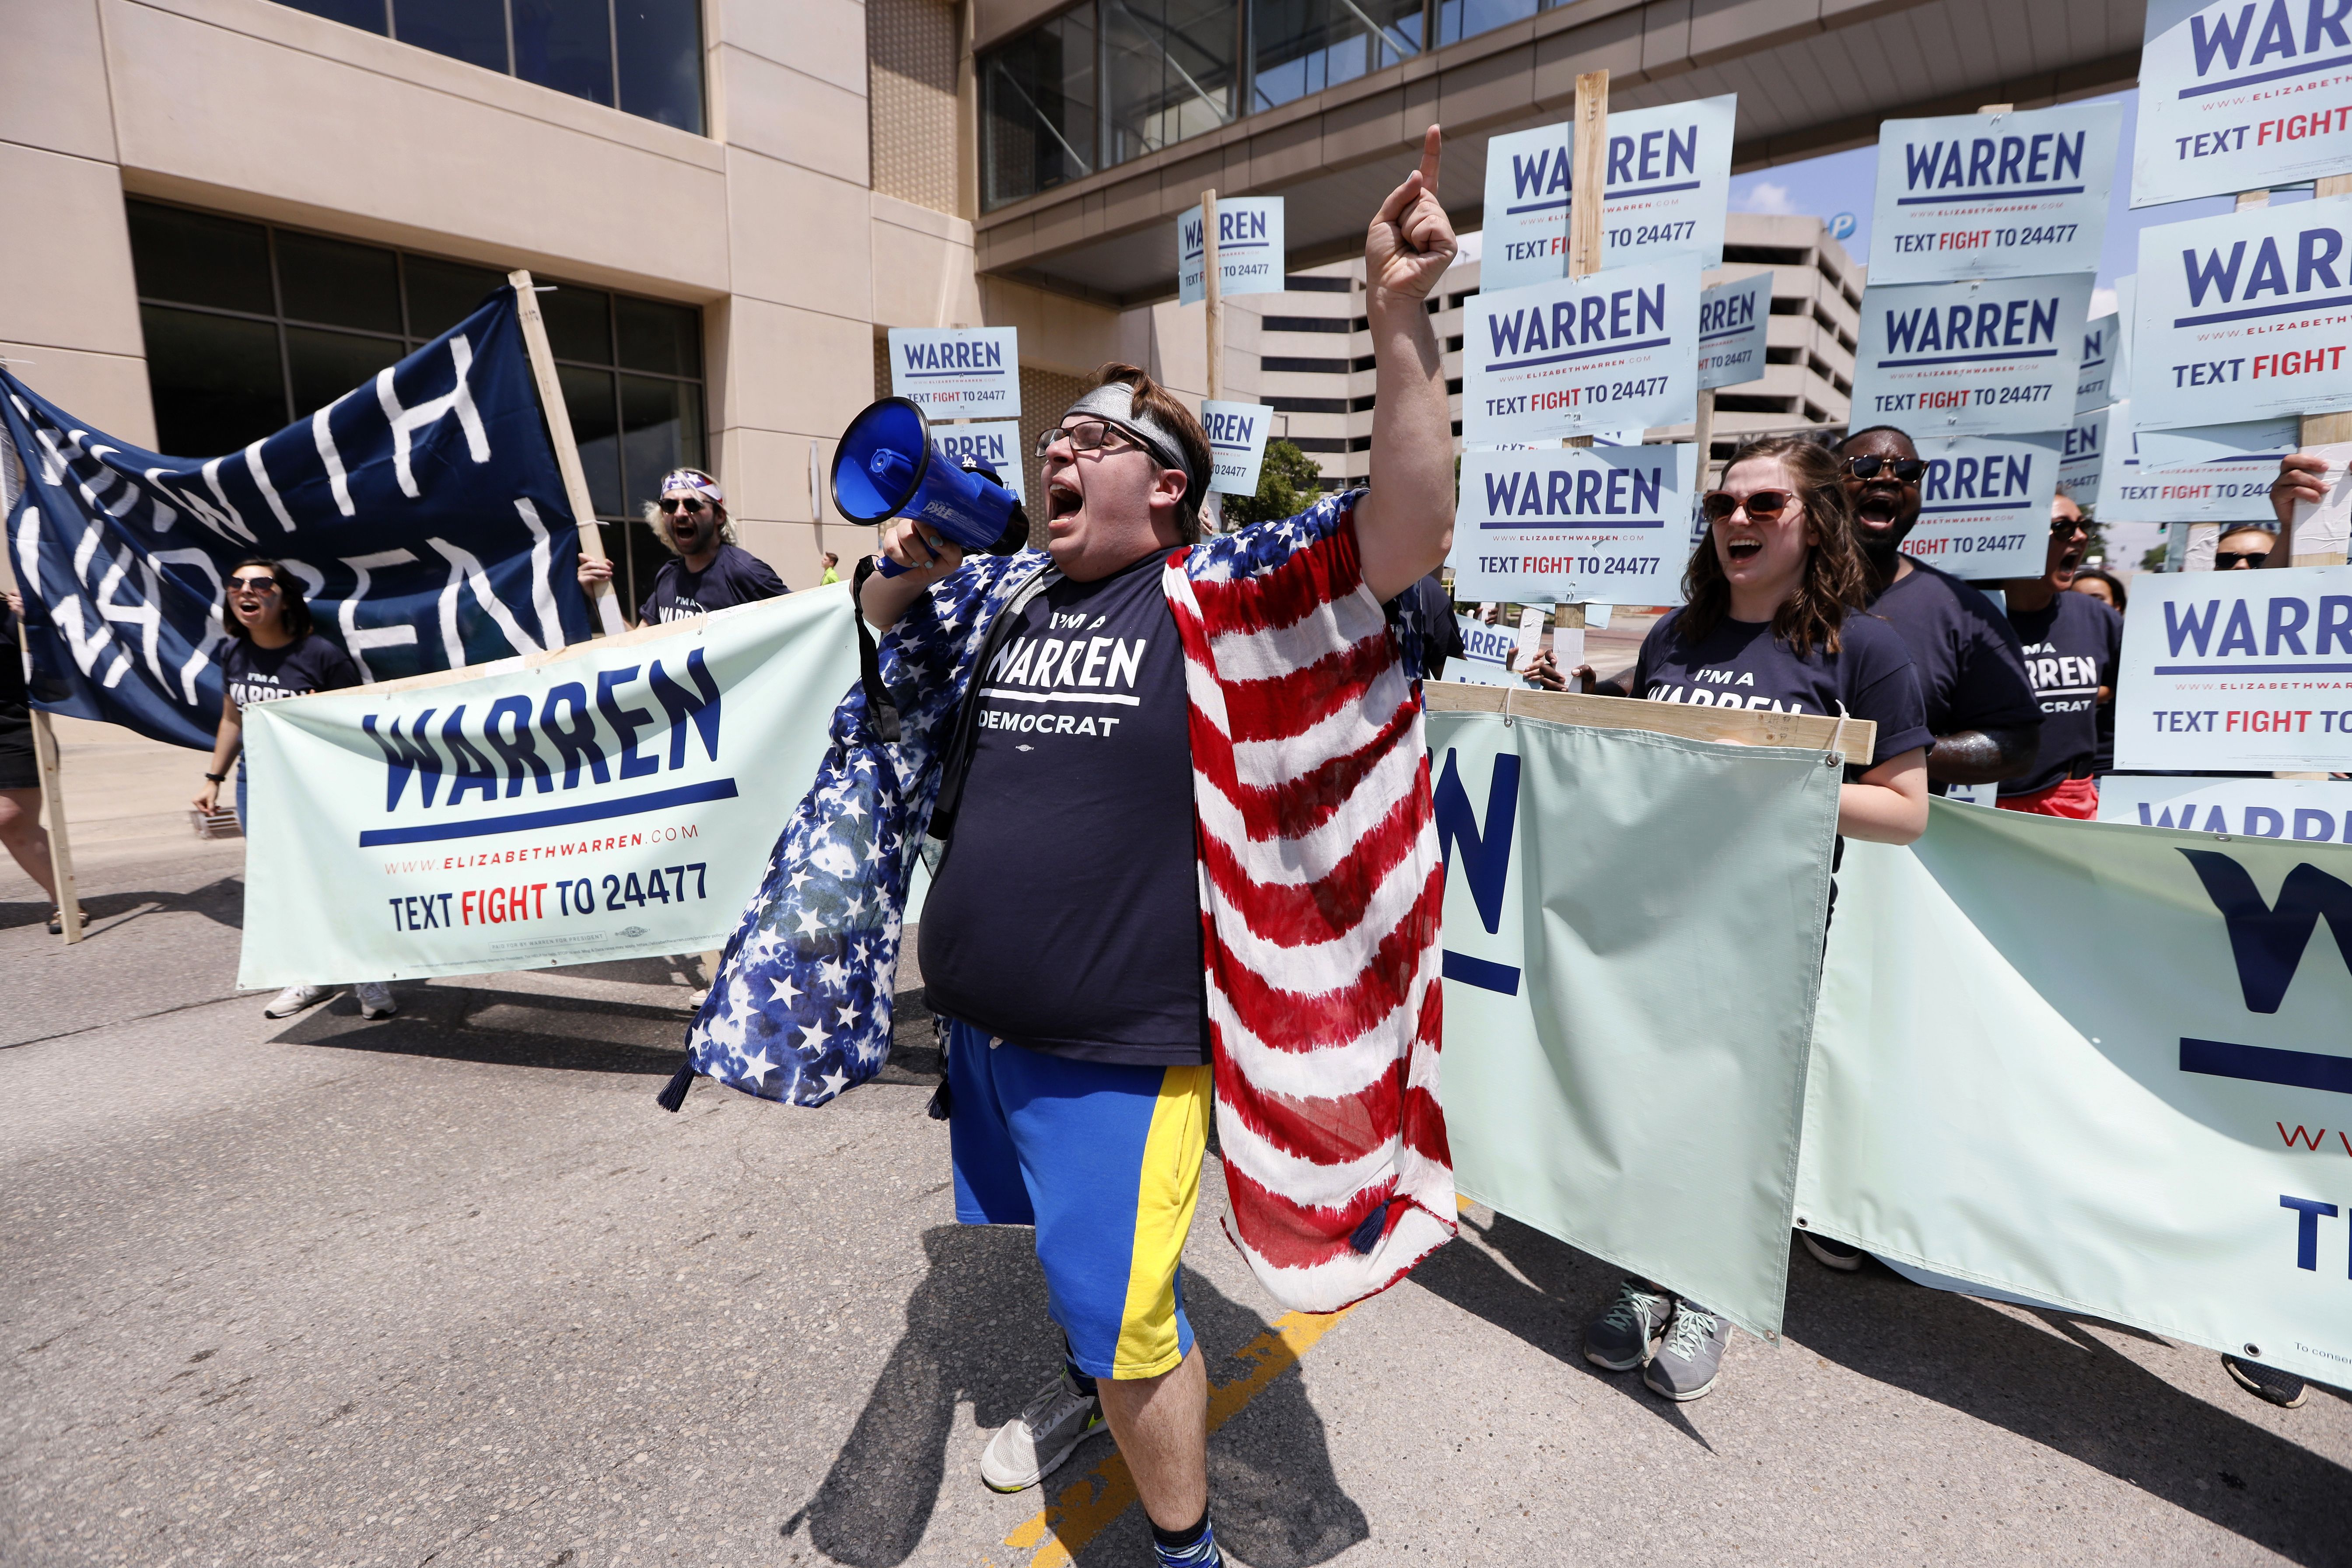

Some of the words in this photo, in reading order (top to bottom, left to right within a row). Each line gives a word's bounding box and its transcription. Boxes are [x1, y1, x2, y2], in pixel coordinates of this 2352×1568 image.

[2176, 126, 2250, 160] TEXT
[2258, 106, 2352, 146] FIGHT
[1512, 124, 1698, 199] WAREN
[1906, 130, 2086, 190] WARREN
[1185, 210, 1265, 250] WAREN
[1505, 239, 1547, 261] TEXT
[1609, 228, 1632, 248] TO
[1636, 220, 1697, 245] 24477
[1894, 233, 1937, 254] TEXT
[1939, 230, 1992, 251] FIGHT
[1995, 228, 2016, 248] TO
[2020, 224, 2079, 246] 24477
[1186, 273, 1198, 287] TEXT
[1224, 266, 1236, 276] TO
[1239, 264, 1269, 275] 24477
[2182, 227, 2352, 308] WAR
[1488, 283, 1665, 357] WARREN
[1700, 290, 1756, 334] RREN
[1886, 297, 2060, 354] WARREN
[904, 341, 1001, 369] WARREN
[1499, 355, 1651, 382] WWW.ELIZABETHWARREN.COM
[1712, 355, 1723, 368] TO
[1725, 349, 1753, 366] 24477
[2172, 358, 2245, 388] TEXT
[2253, 346, 2346, 379] FIGHT
[1890, 364, 2040, 380] WWW.ELIZABETHWARREN.COM
[907, 393, 931, 403] TEXT
[933, 392, 960, 402] FIGHT
[962, 391, 975, 401] TO
[977, 390, 1005, 400] 24477
[1486, 396, 1527, 416] TEXT
[1531, 388, 1582, 411] FIGHT
[1586, 384, 1607, 404] TO
[1612, 376, 1669, 401] 24477
[1875, 393, 1916, 413] TEXT
[1919, 389, 1971, 410] FIGHT
[1974, 388, 1996, 406] TO
[1999, 384, 2053, 404] 24477
[1202, 413, 1254, 443] RREN
[933, 434, 1004, 459] RREN
[1221, 465, 1246, 477] 24477
[1925, 453, 2032, 500] RREN
[1484, 467, 1662, 516] WARREN
[2121, 486, 2159, 499] TEXT
[2161, 485, 2212, 499] FIGHT
[2217, 485, 2238, 497] TO
[1903, 538, 1950, 555] FIGHT
[1953, 537, 1974, 553] TO
[1977, 534, 2027, 552] 24477
[1479, 556, 1519, 574] TEXT
[1522, 556, 1574, 574] FIGHT
[1578, 557, 1600, 574] TO
[1604, 557, 1660, 574] 24477
[676, 596, 689, 606] I'M
[690, 598, 696, 607] A
[1049, 612, 1087, 630] I'M
[1087, 615, 1106, 630] A
[2042, 642, 2056, 653] A
[268, 676, 280, 684] A
[1694, 668, 1734, 684] I'M
[1735, 672, 1754, 686] A
[2024, 656, 2096, 689] RREN
[2040, 700, 2091, 713] CRAT
[362, 647, 721, 812] WARREN
[978, 710, 1119, 737] DEMOCRAT
[2153, 711, 2219, 732] TEXT
[2226, 711, 2312, 732] FIGHT
[2320, 711, 2352, 733] TO
[385, 824, 698, 875] WWW.ELIZABETHWARREN.COM
[389, 893, 452, 931] TEXT
[462, 882, 547, 925] FIGHT
[556, 878, 595, 916] TO
[602, 862, 707, 911] 24477
[2294, 1342, 2308, 1352] To
